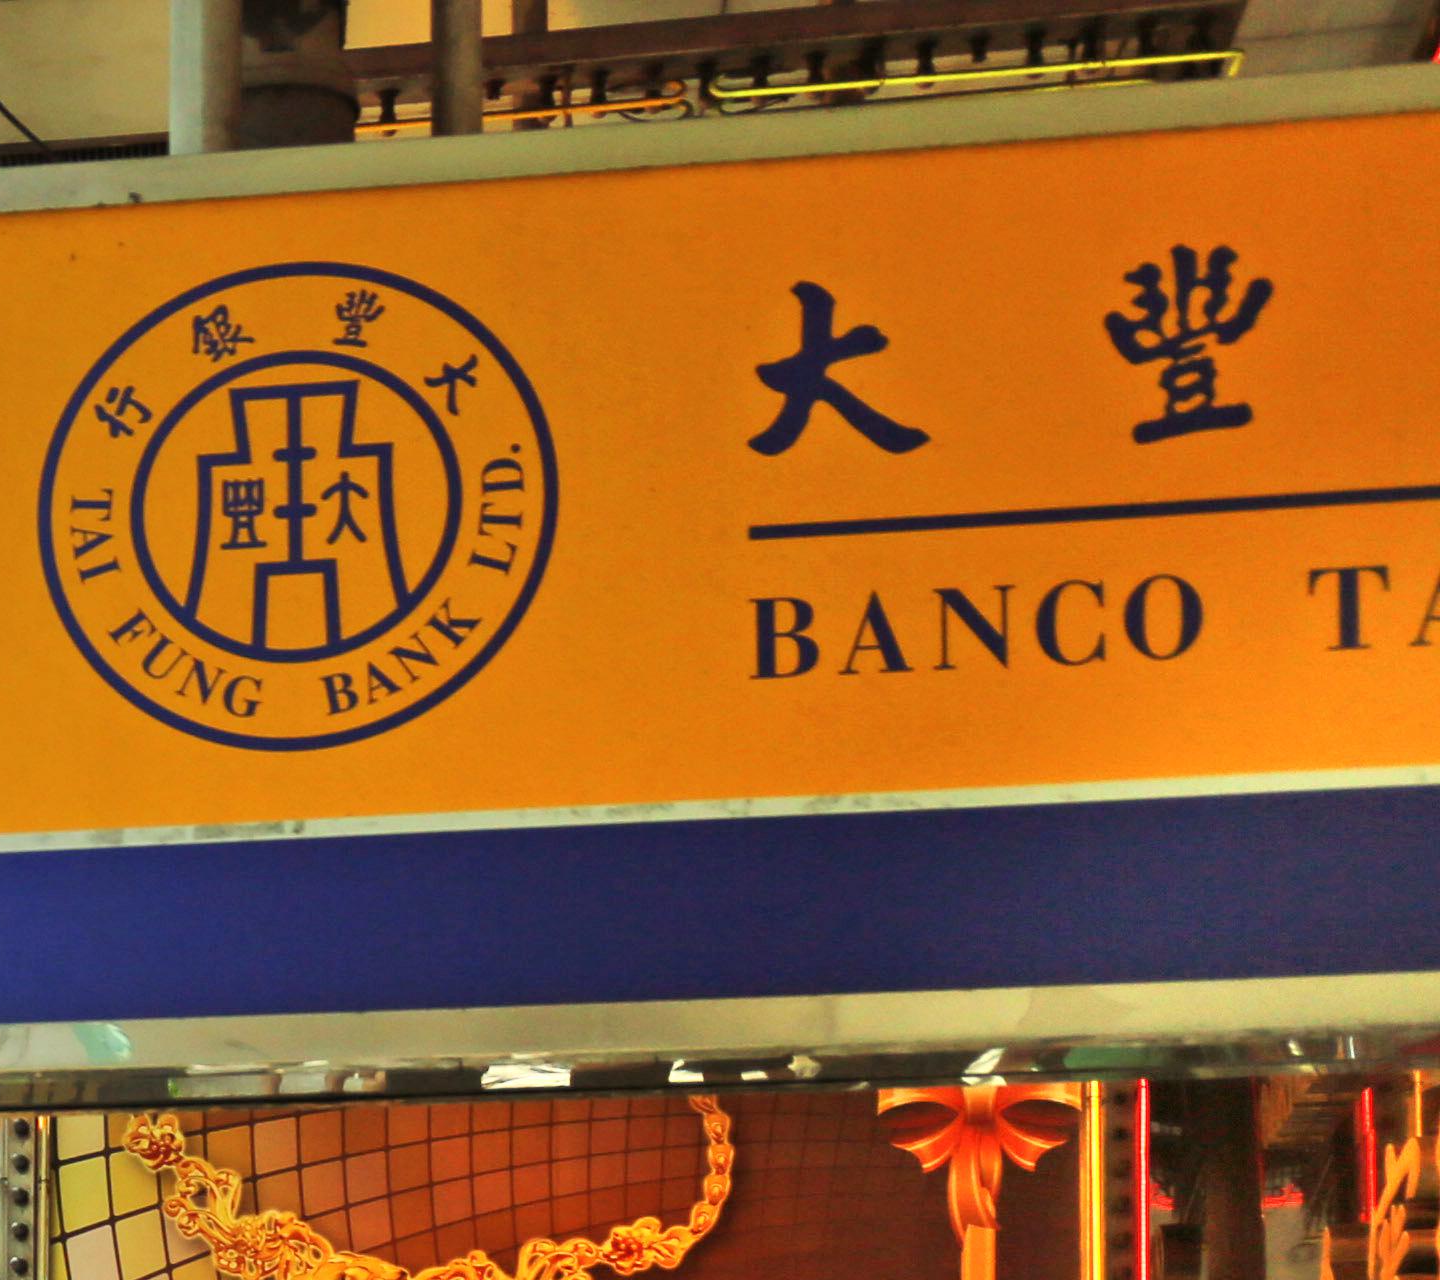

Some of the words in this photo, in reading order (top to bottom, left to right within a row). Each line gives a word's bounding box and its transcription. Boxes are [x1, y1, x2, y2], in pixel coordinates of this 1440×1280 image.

[747, 244, 1274, 457] 大豐
[69, 487, 121, 583] TAI
[107, 607, 263, 720] FUNG
[319, 600, 484, 717] BANK
[748, 573, 1204, 681] BANCO
